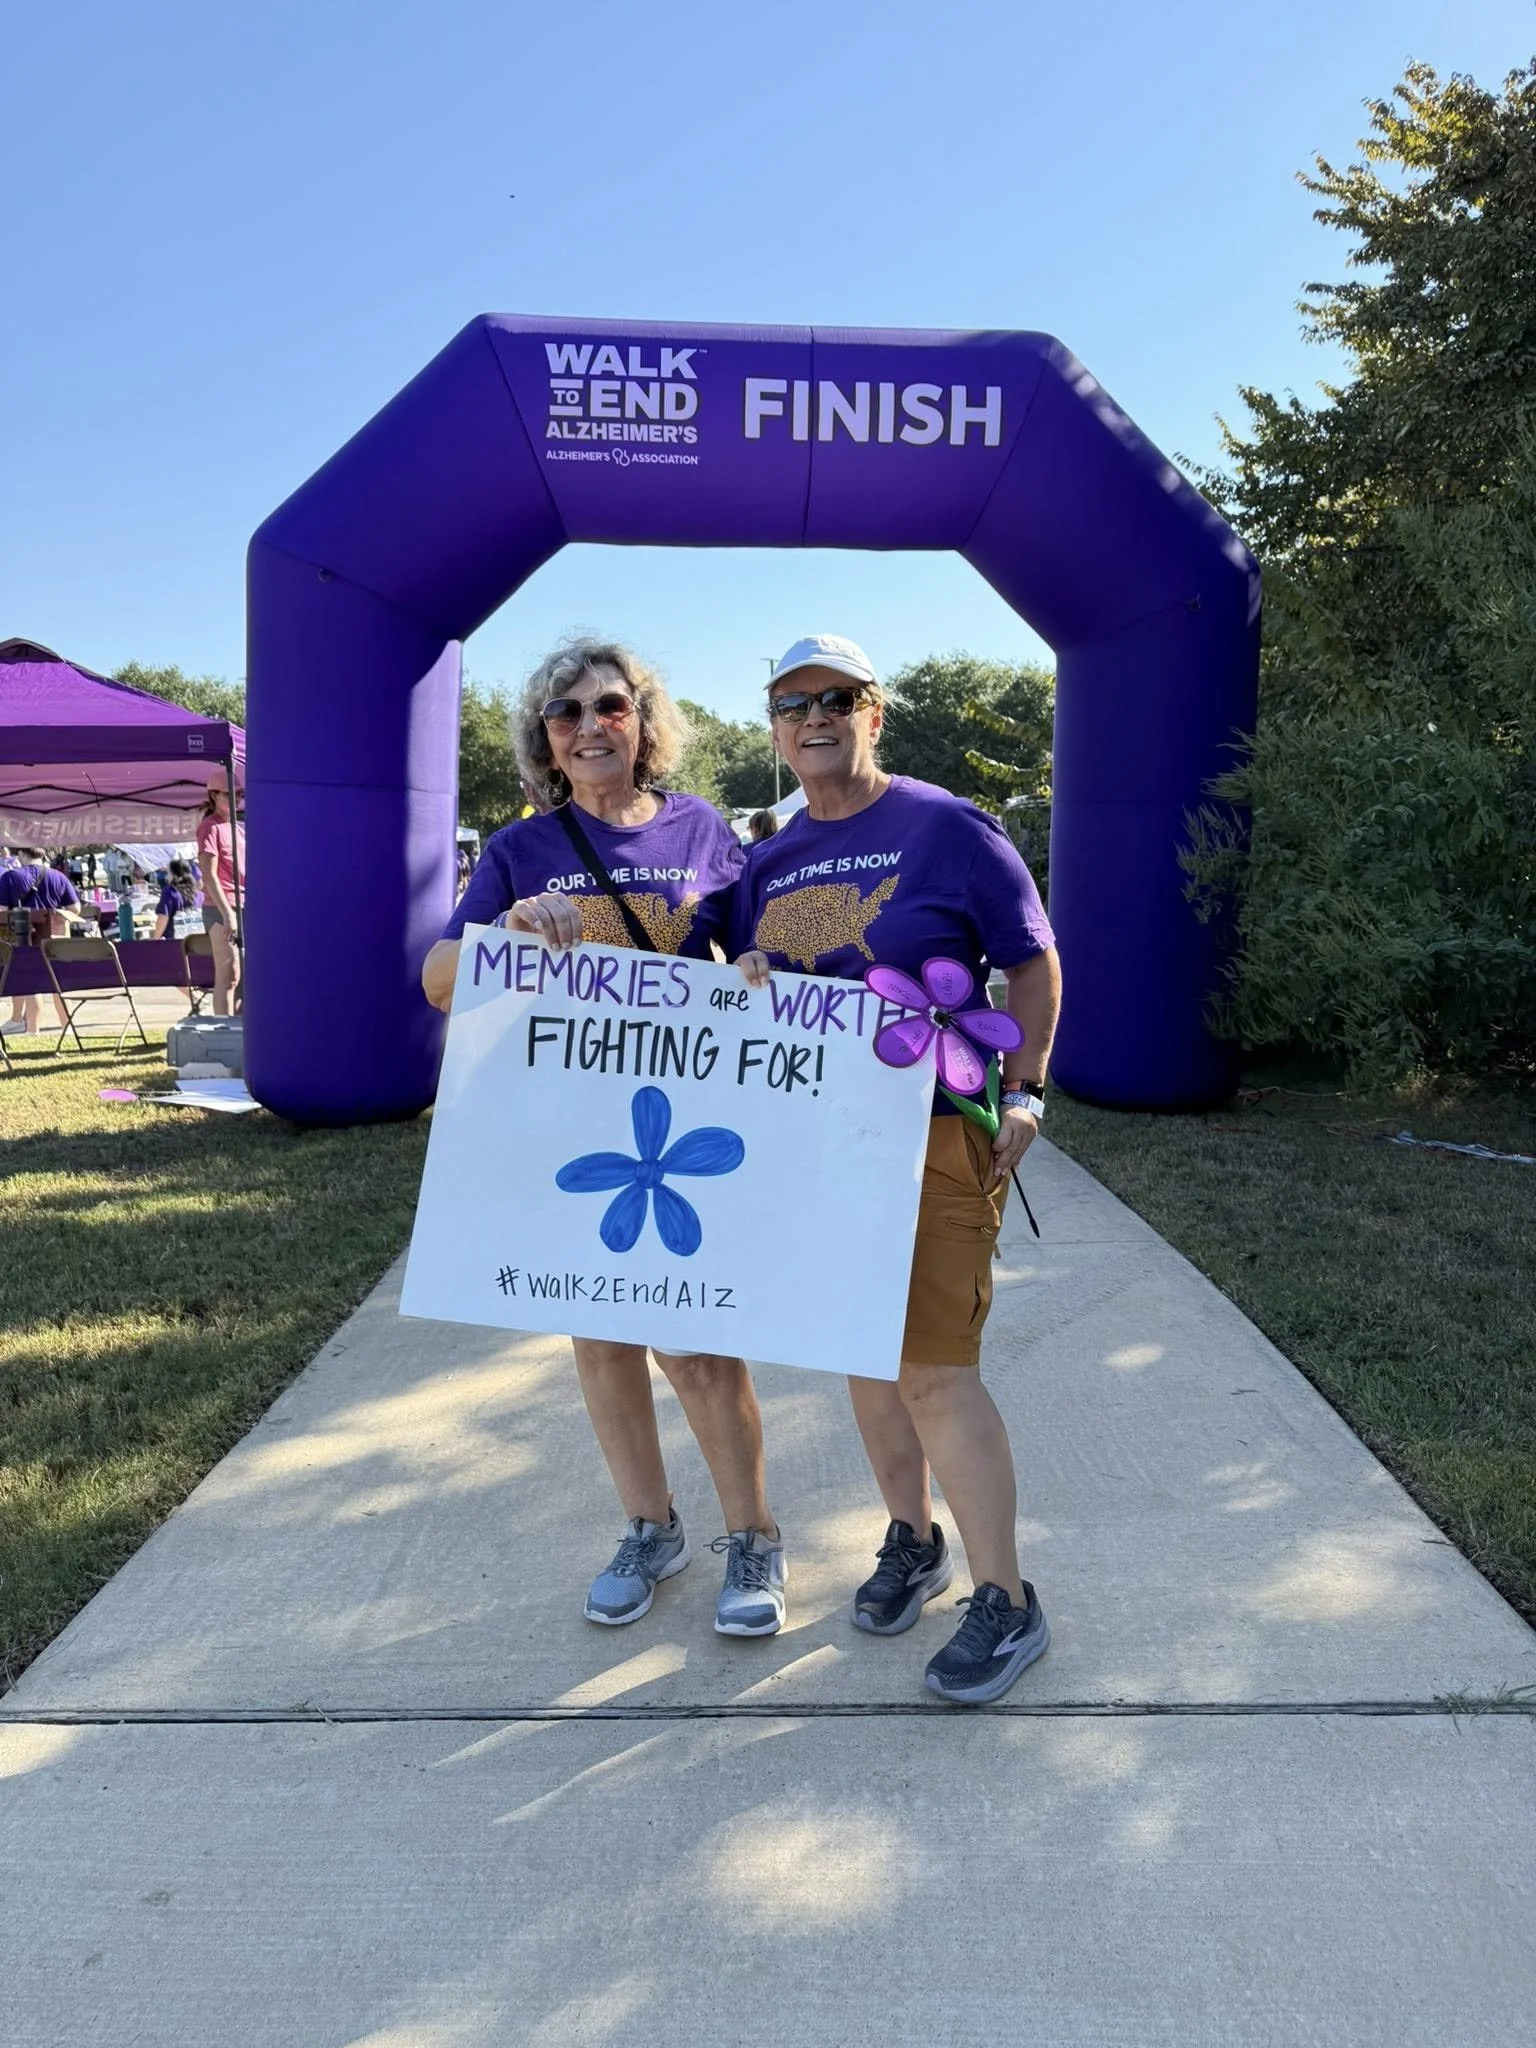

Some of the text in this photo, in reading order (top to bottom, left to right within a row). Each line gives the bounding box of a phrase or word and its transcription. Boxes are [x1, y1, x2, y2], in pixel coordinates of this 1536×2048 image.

[544, 343, 698, 379] WALK
[553, 379, 698, 420] TO END
[744, 377, 1002, 447] FINISH
[545, 420, 698, 444] ALZHEIMER'S
[545, 449, 698, 465] ALZHEIMER'S ASSOCIATION
[546, 867, 698, 893] OUR TME IS NOW
[766, 851, 902, 892] OUR TIME IS NOW
[473, 940, 690, 1009] MEMORIES
[709, 986, 750, 1013] are
[528, 1015, 825, 1097] FIGHTING FOR!
